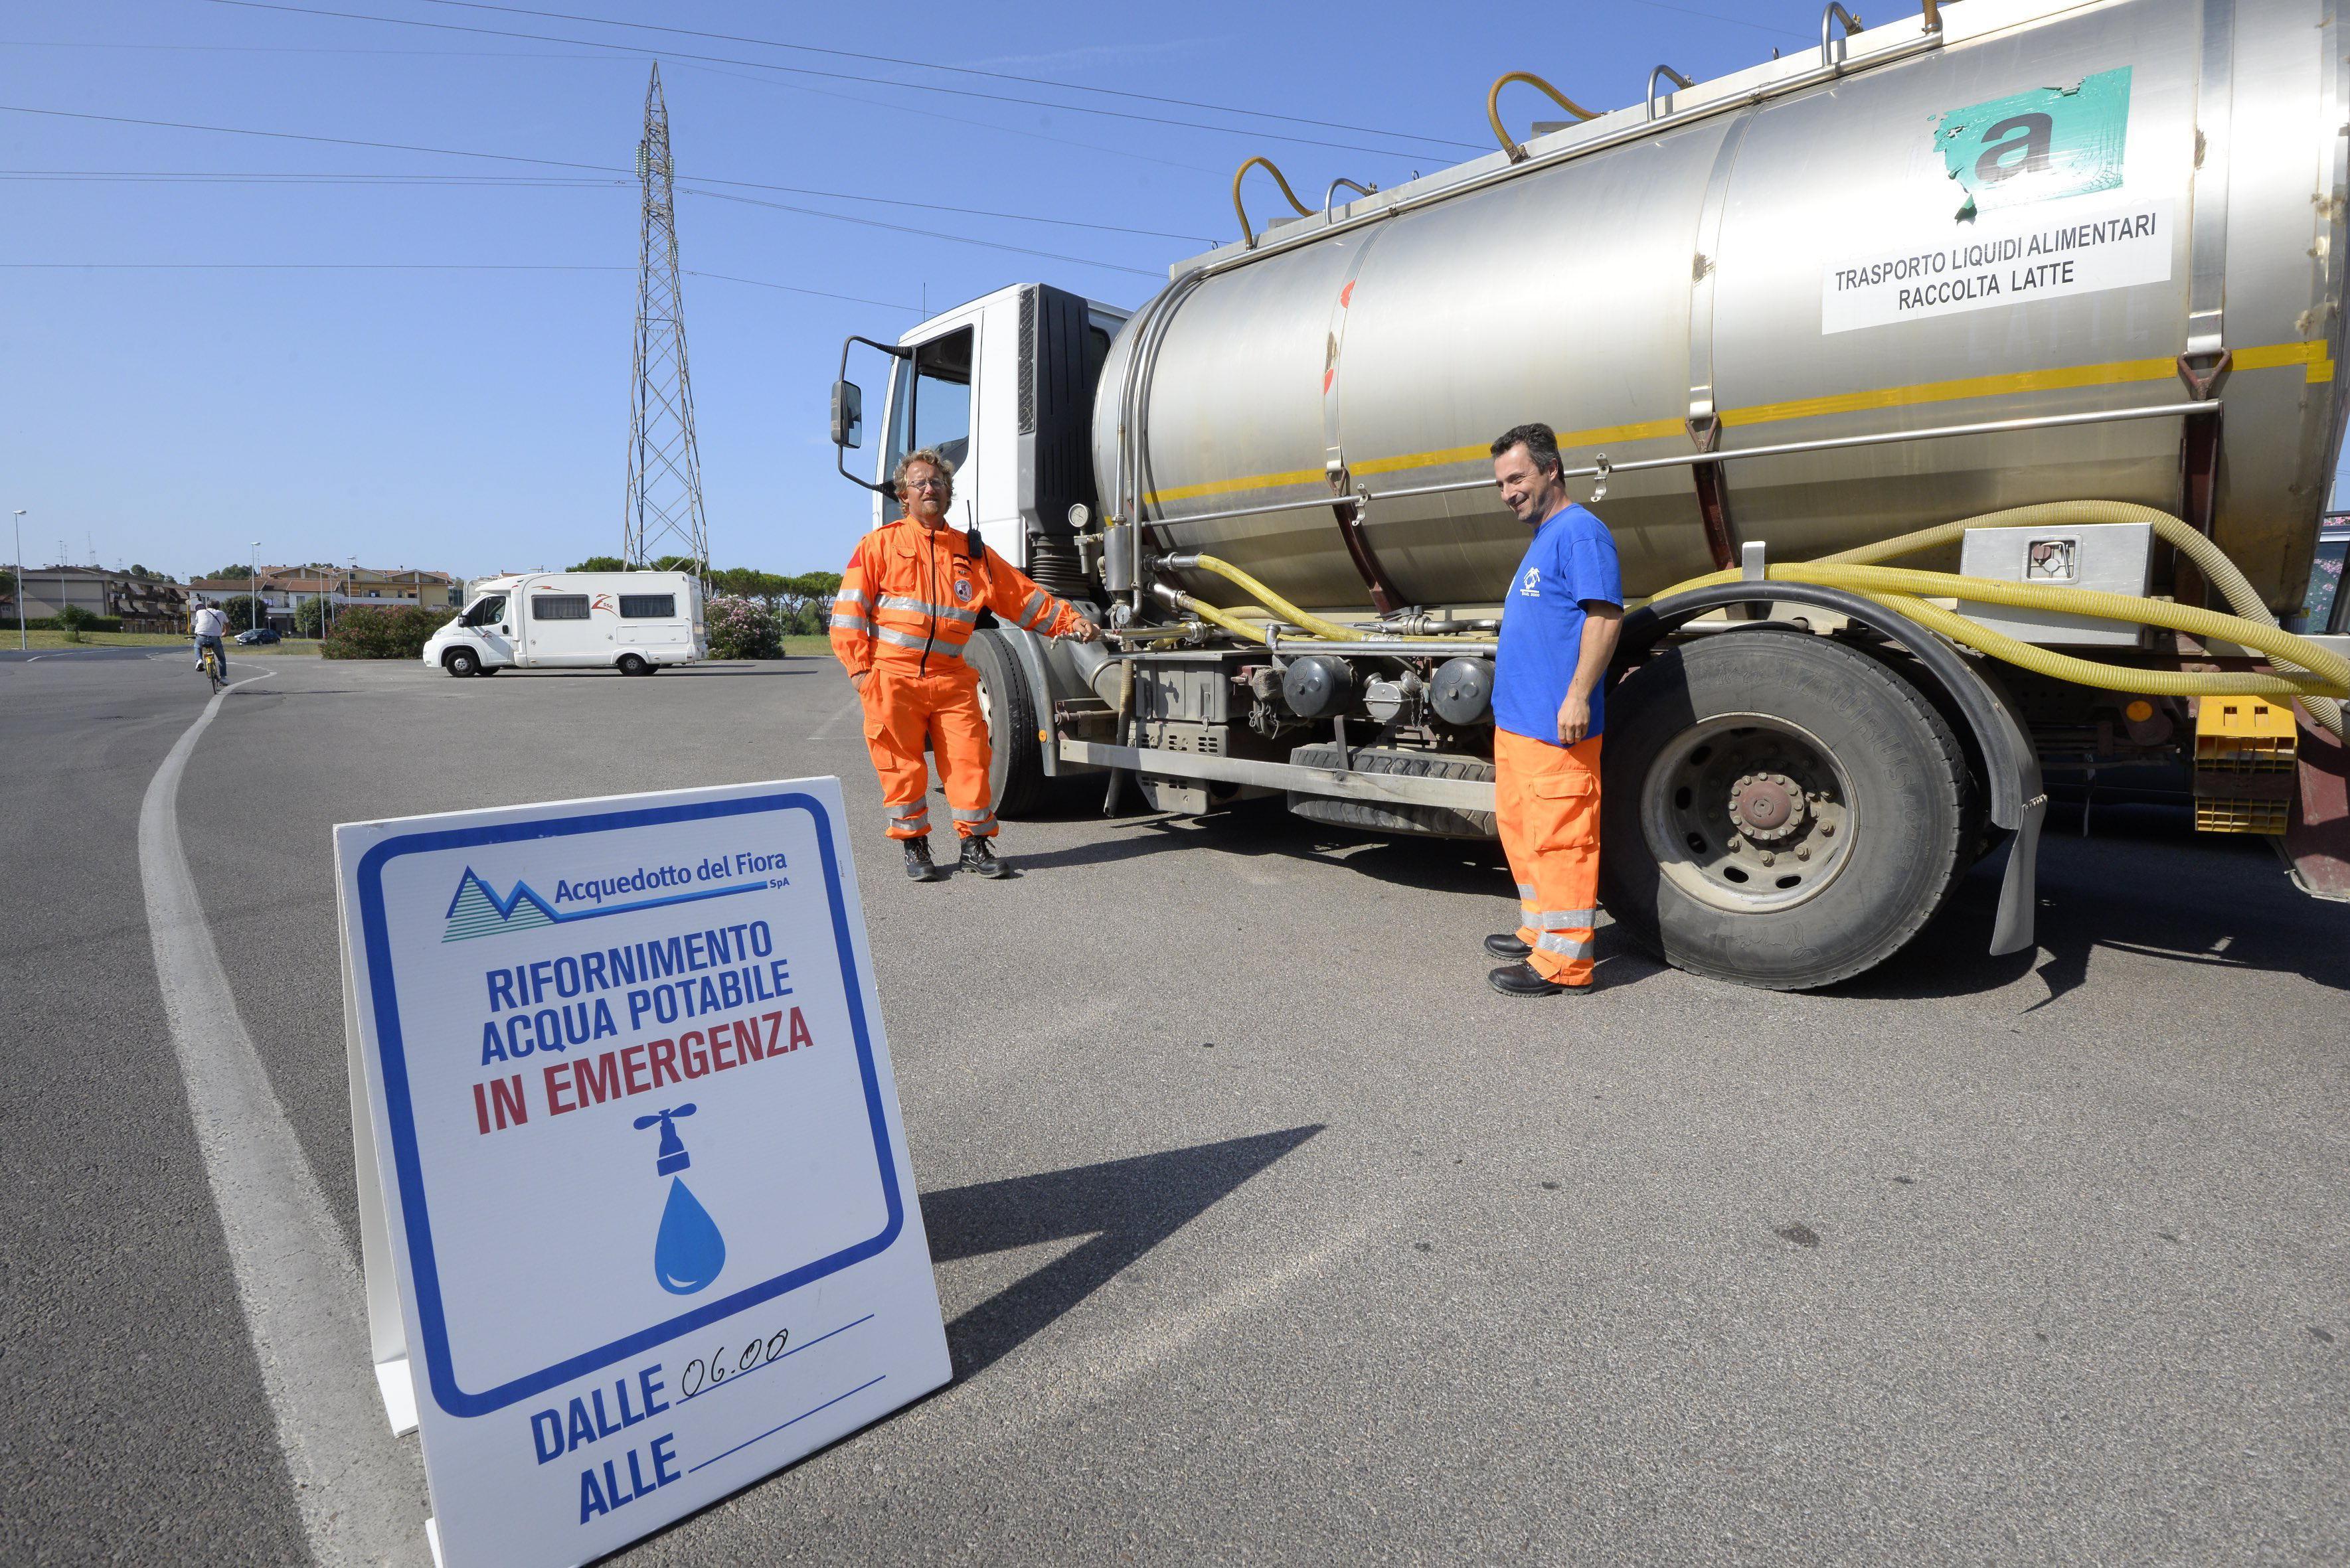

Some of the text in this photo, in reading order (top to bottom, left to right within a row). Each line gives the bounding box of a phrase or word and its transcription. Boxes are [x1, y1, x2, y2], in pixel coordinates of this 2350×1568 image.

[1974, 112, 2053, 183] a
[1835, 212, 2157, 291] TRASPORTO LIQUIDI ALIMENTARI
[1898, 260, 2075, 311] RACCOLTA LATTE
[554, 852, 788, 904] Acquedotto del Fiora
[770, 877, 790, 890] SpA
[486, 920, 773, 1013] RIFORNIMENTO
[481, 959, 794, 1066] ACQUA POTABILE
[472, 1006, 814, 1135] IN EMERGENZA
[681, 1328, 789, 1397] 06.00
[529, 1363, 670, 1466] DALLE
[580, 1431, 682, 1526] ALLE
